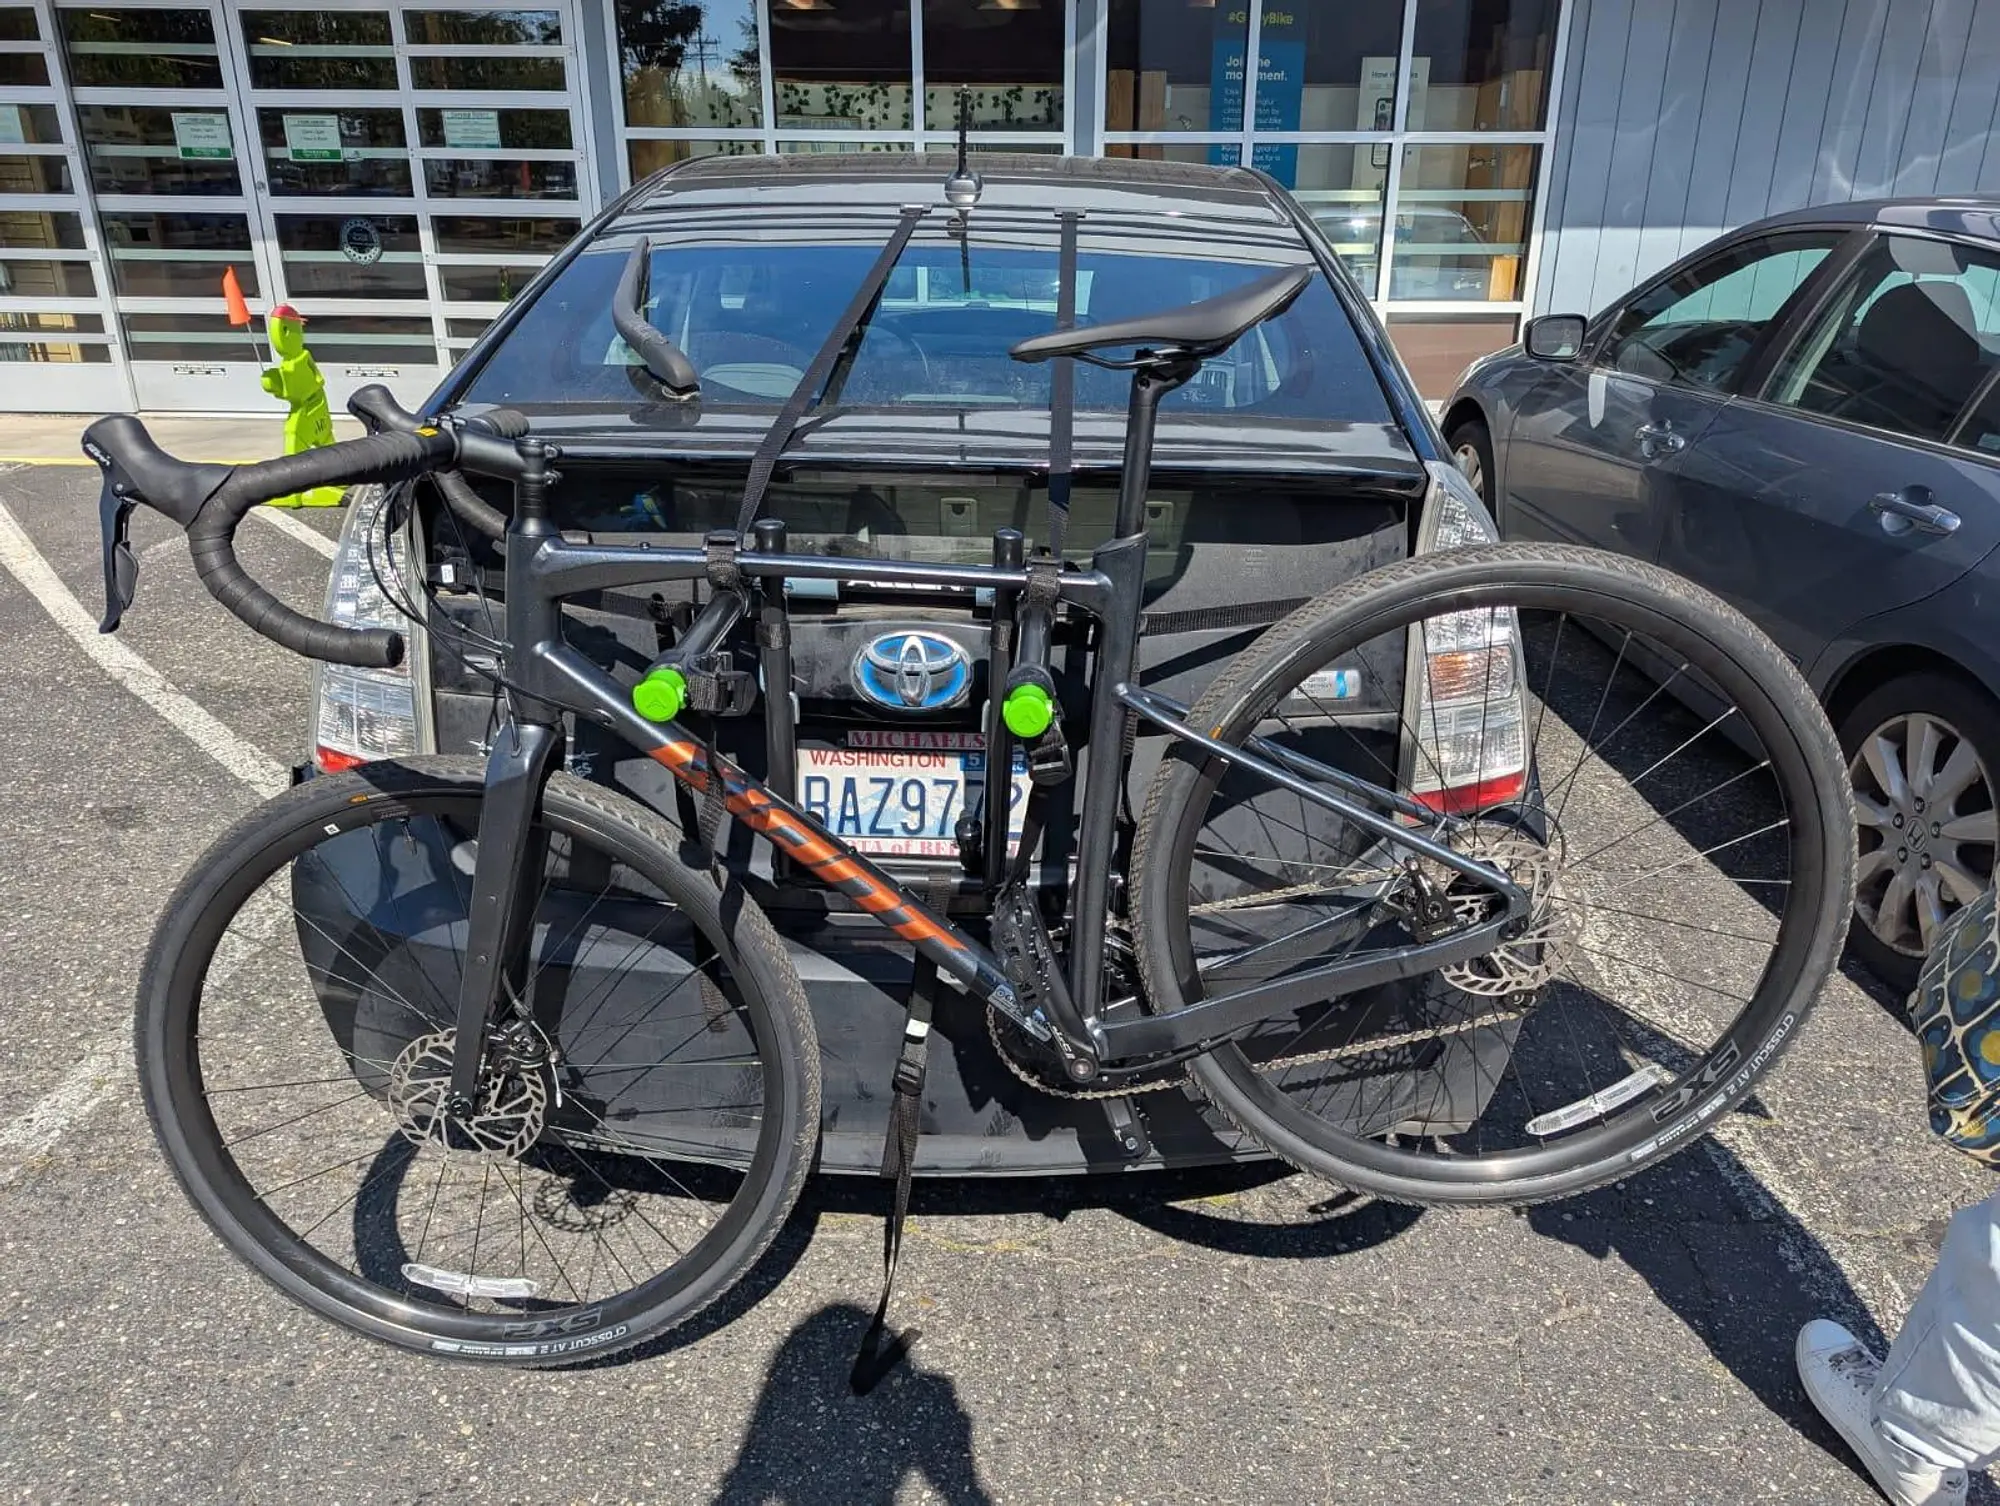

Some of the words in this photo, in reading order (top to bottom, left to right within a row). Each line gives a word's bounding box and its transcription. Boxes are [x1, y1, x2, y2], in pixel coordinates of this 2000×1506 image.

[1228, 11, 1293, 27] #GyBike
[1225, 70, 1288, 81] moment.
[811, 750, 946, 769] WASHINGTON
[968, 752, 980, 766] 5
